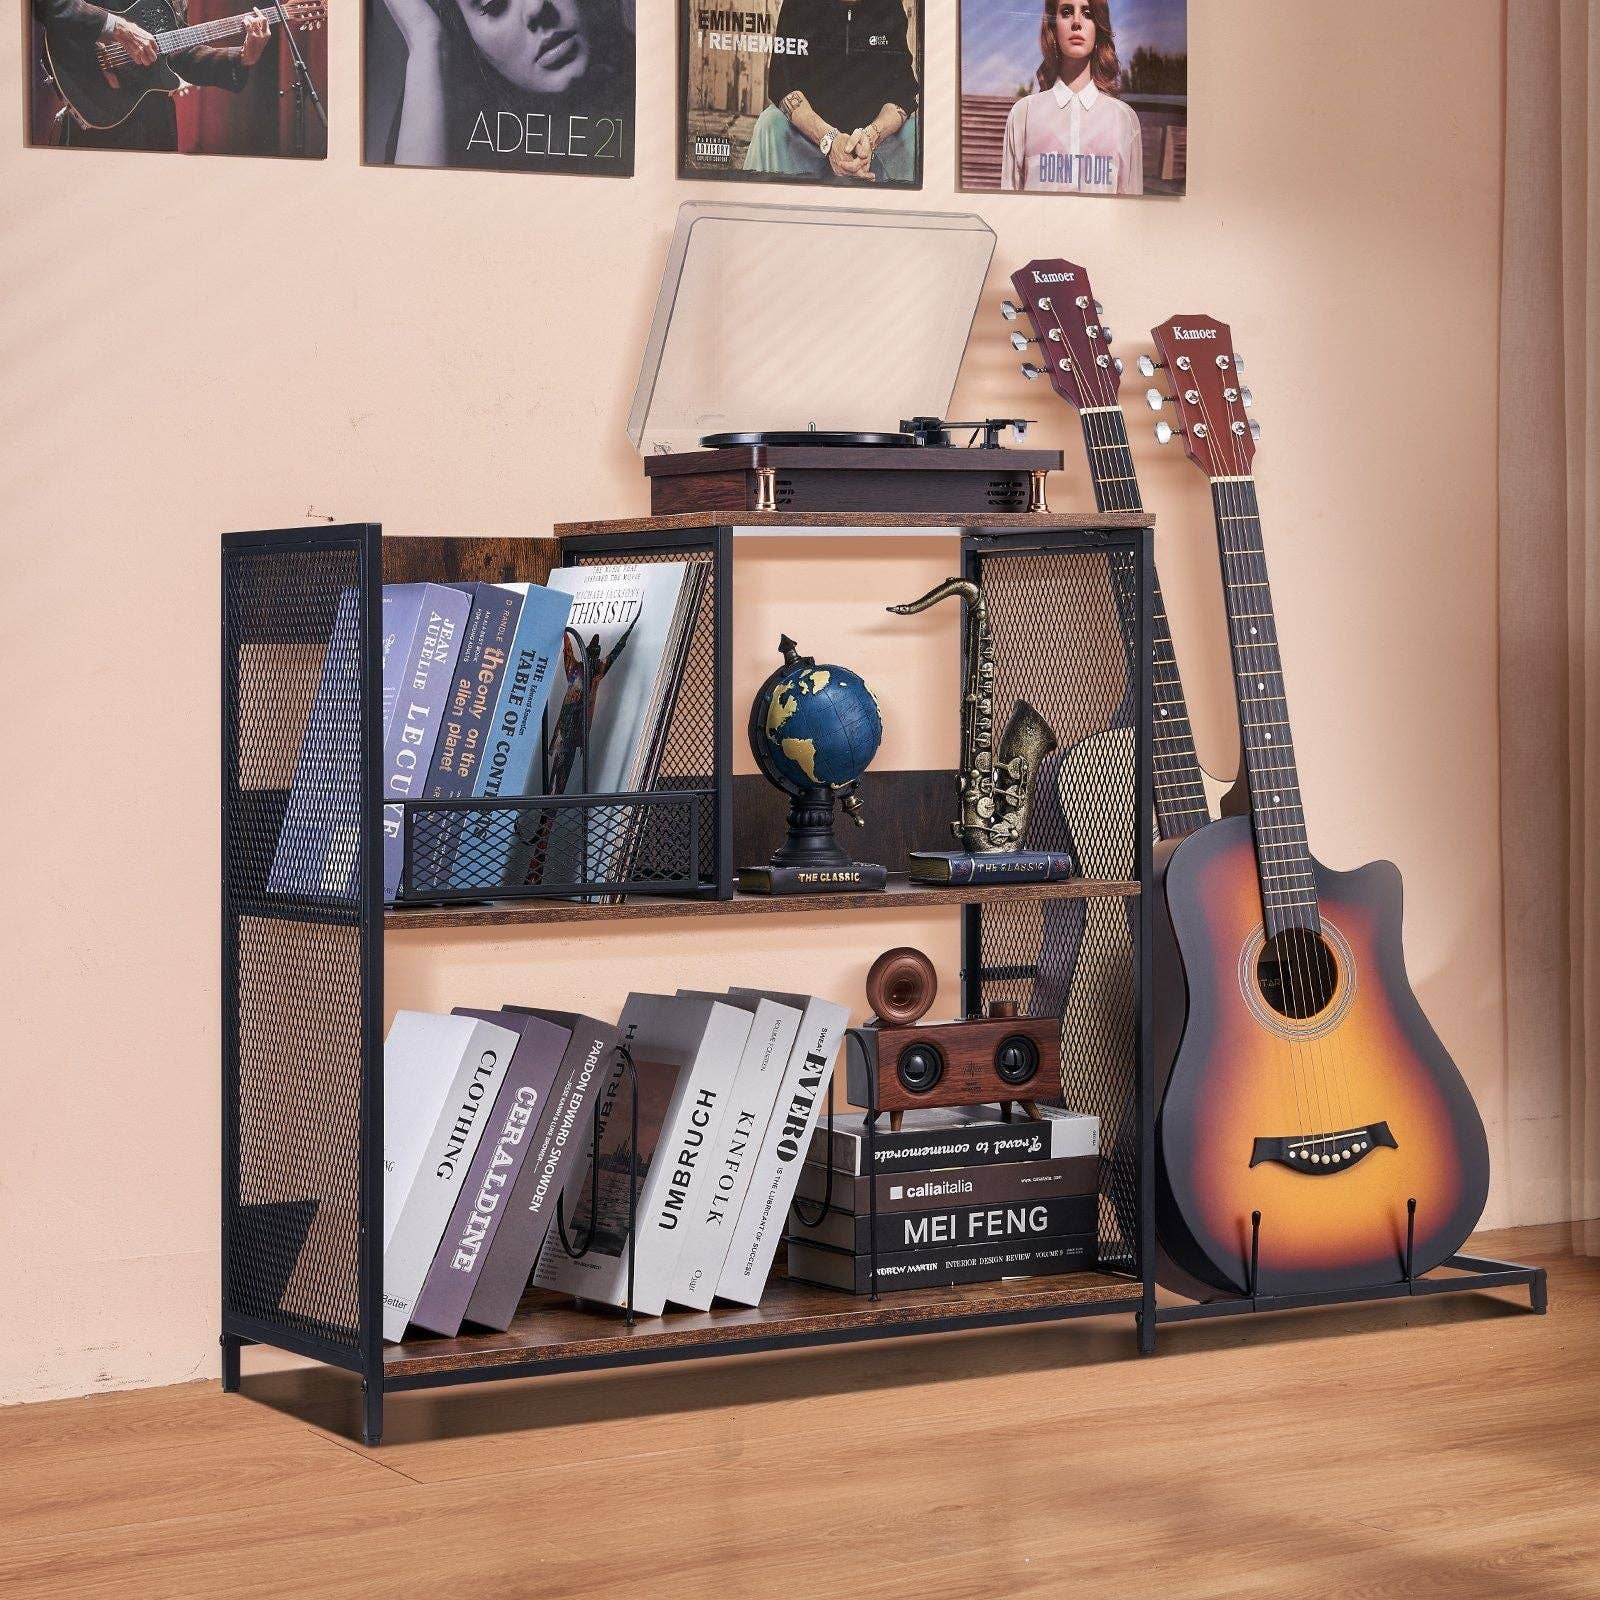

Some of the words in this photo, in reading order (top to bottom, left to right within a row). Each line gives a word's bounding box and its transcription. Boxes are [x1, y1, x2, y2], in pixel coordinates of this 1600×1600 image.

[698, 9, 771, 34] EMINEM
[697, 31, 703, 48] I
[709, 32, 809, 56] REMEMBER
[466, 110, 588, 157] ADELE
[594, 118, 624, 159] 21
[696, 143, 730, 156] ADVISORY
[1038, 152, 1074, 184] BORN
[1074, 153, 1094, 192] TO
[1093, 155, 1114, 186] DIE
[1032, 271, 1075, 284] Kamoer
[1173, 326, 1216, 340] Kamoer
[570, 601, 604, 624] THIS
[602, 600, 619, 623] IS
[617, 600, 637, 623] IT
[413, 611, 441, 689] AURELIE
[434, 618, 455, 664] JEAN
[479, 646, 504, 684] the
[509, 650, 536, 706] TABLE
[533, 657, 549, 682] THE
[452, 679, 472, 717] alien
[469, 684, 488, 719] only
[502, 710, 518, 737] OF
[439, 722, 462, 772] planet
[465, 728, 479, 749] on
[458, 753, 475, 777] the
[798, 873, 819, 883] THE
[820, 872, 861, 883] CLASSIC
[978, 862, 999, 872] THE
[1000, 860, 1045, 872] CLASSIC
[815, 1027, 828, 1052] SWEAT
[576, 1040, 604, 1092] PARDON
[437, 1049, 497, 1181] CLOTHING
[555, 1092, 584, 1146] EDWARD
[777, 1051, 827, 1162] EVERO
[875, 1143, 970, 1163] commemorate
[976, 1142, 990, 1153] to
[994, 1135, 1042, 1155] Travel
[659, 1089, 716, 1231] UMBRUCH
[706, 1110, 756, 1226] KINFOLK
[777, 1167, 783, 1175] IS
[450, 1086, 538, 1273] CERALDINE
[529, 1147, 562, 1213] SNOWDEN
[772, 1175, 781, 1190] THE
[906, 1180, 973, 1199] caliaitalia
[759, 1190, 777, 1231] LUBRICANT
[755, 1230, 763, 1242] OF
[904, 1216, 957, 1245] MEI
[968, 1206, 1049, 1238] FENG
[744, 1242, 759, 1277] SUCCESS
[906, 1262, 938, 1274] MARTIN
[945, 1258, 977, 1270] INTERIOR
[979, 1255, 1004, 1265] DESIGN
[1005, 1253, 1032, 1263] REVIEW
[1035, 1250, 1058, 1259] VOLUME
[382, 1294, 408, 1310] Better
